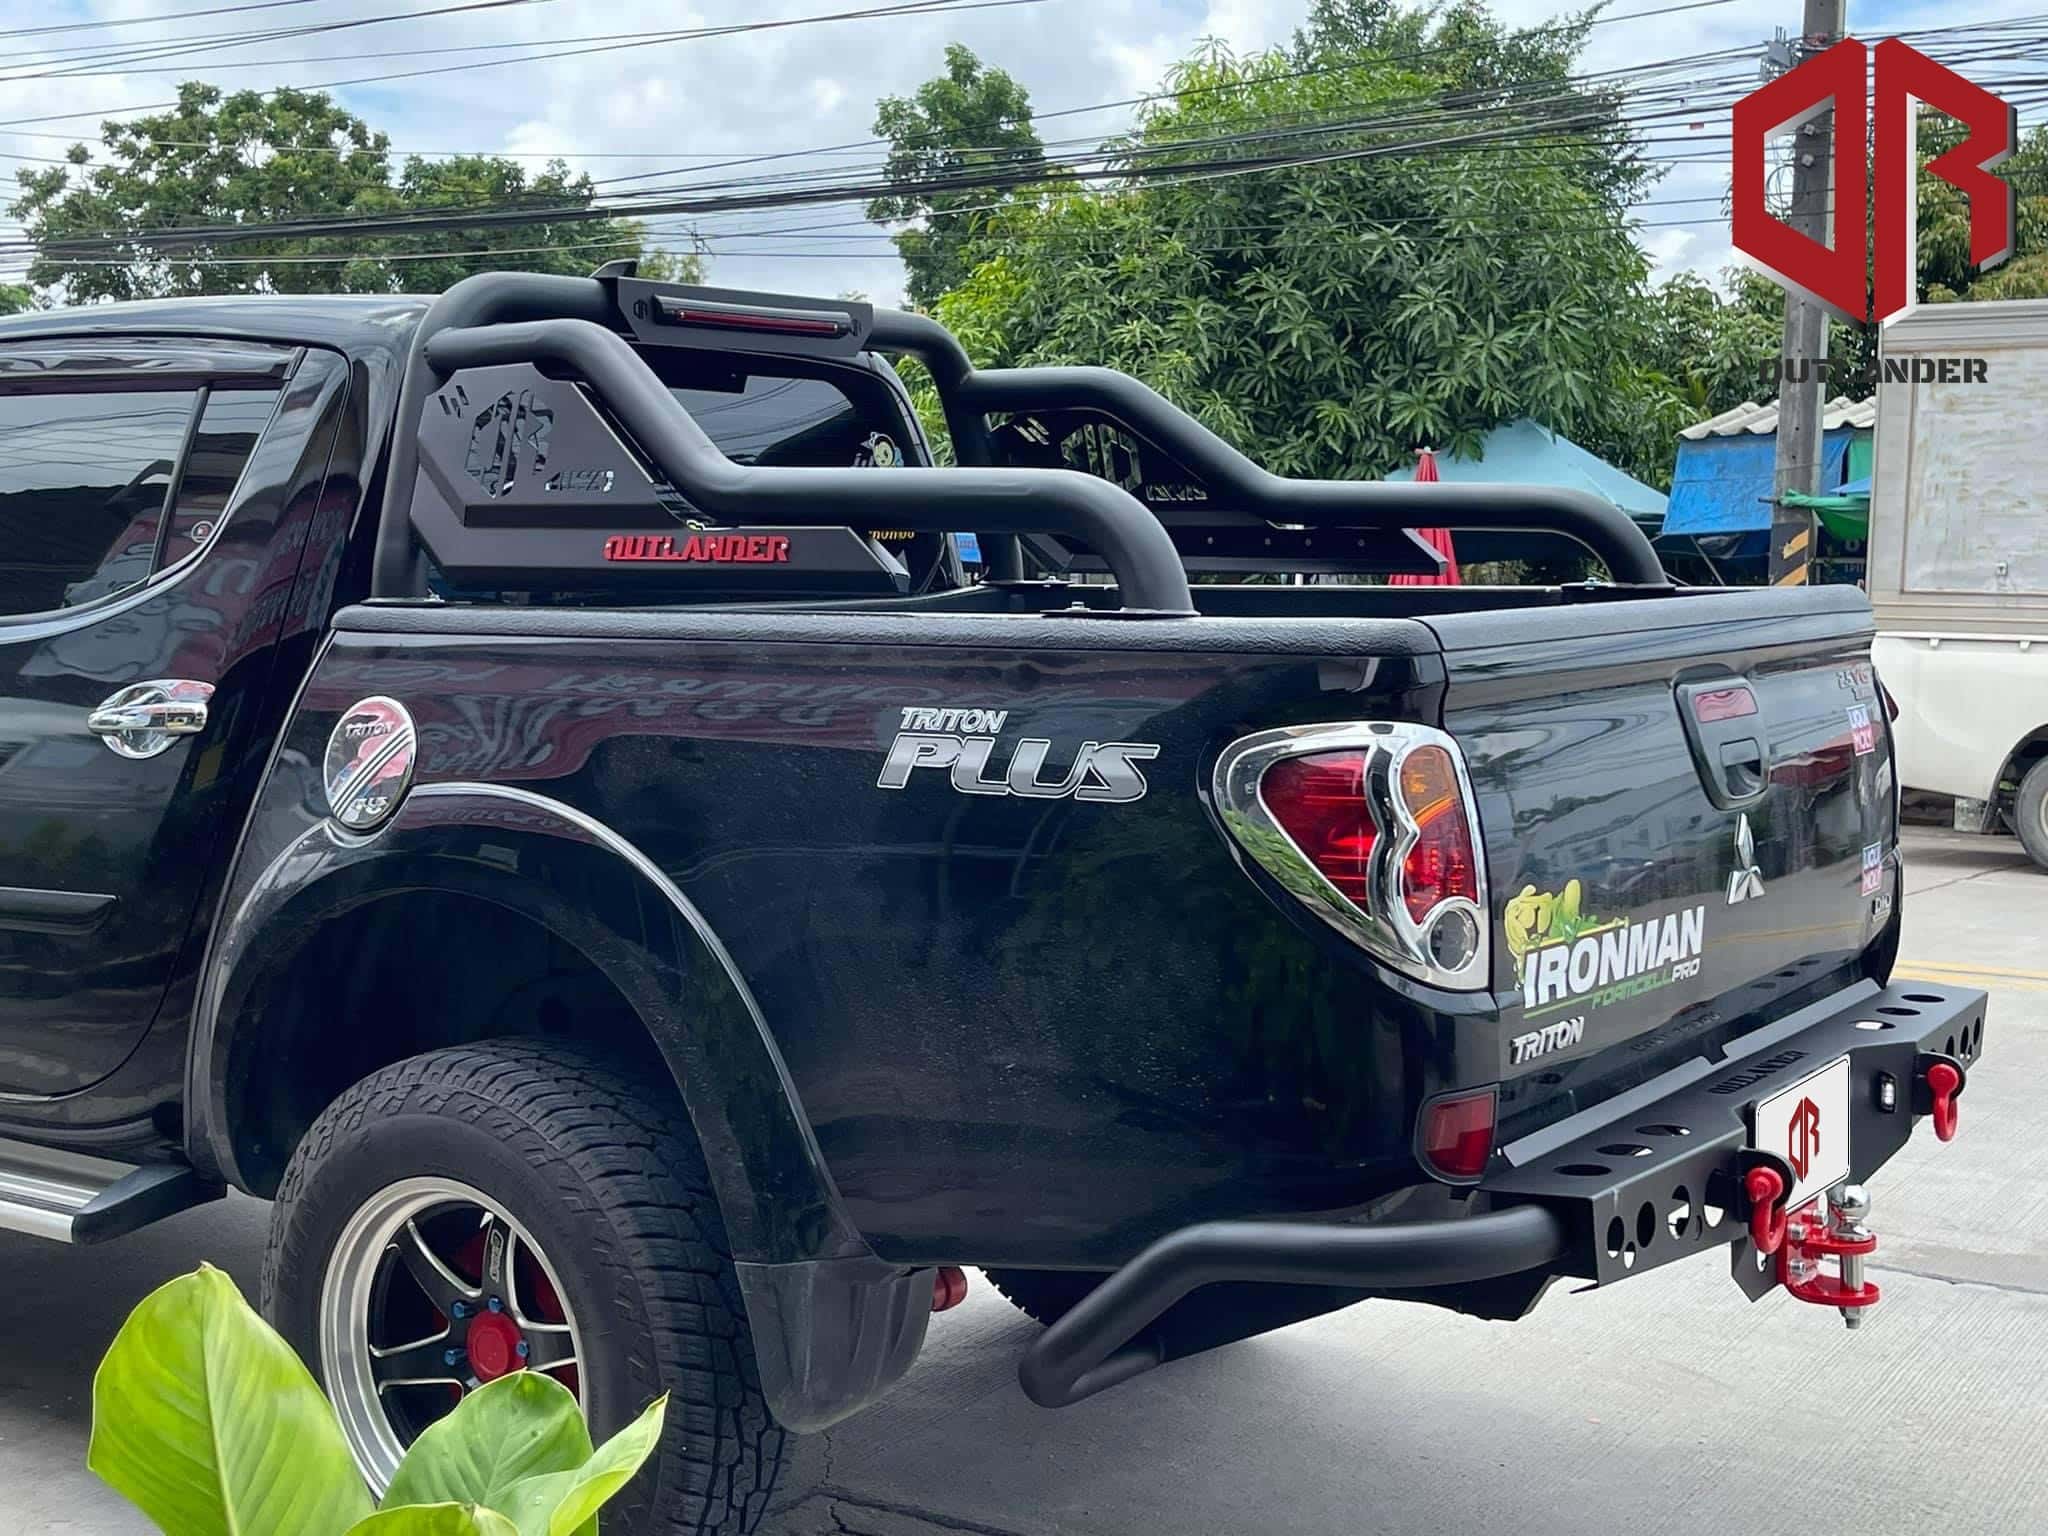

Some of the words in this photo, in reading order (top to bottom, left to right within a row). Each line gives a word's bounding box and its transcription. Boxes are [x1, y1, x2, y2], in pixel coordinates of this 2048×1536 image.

[603, 535, 790, 562] OUTLANDER
[900, 706, 1009, 733] TRITON
[876, 733, 1161, 803] PLUS
[1524, 906, 1705, 1009] IRONMAN
[1511, 1016, 1585, 1064] TRITON
